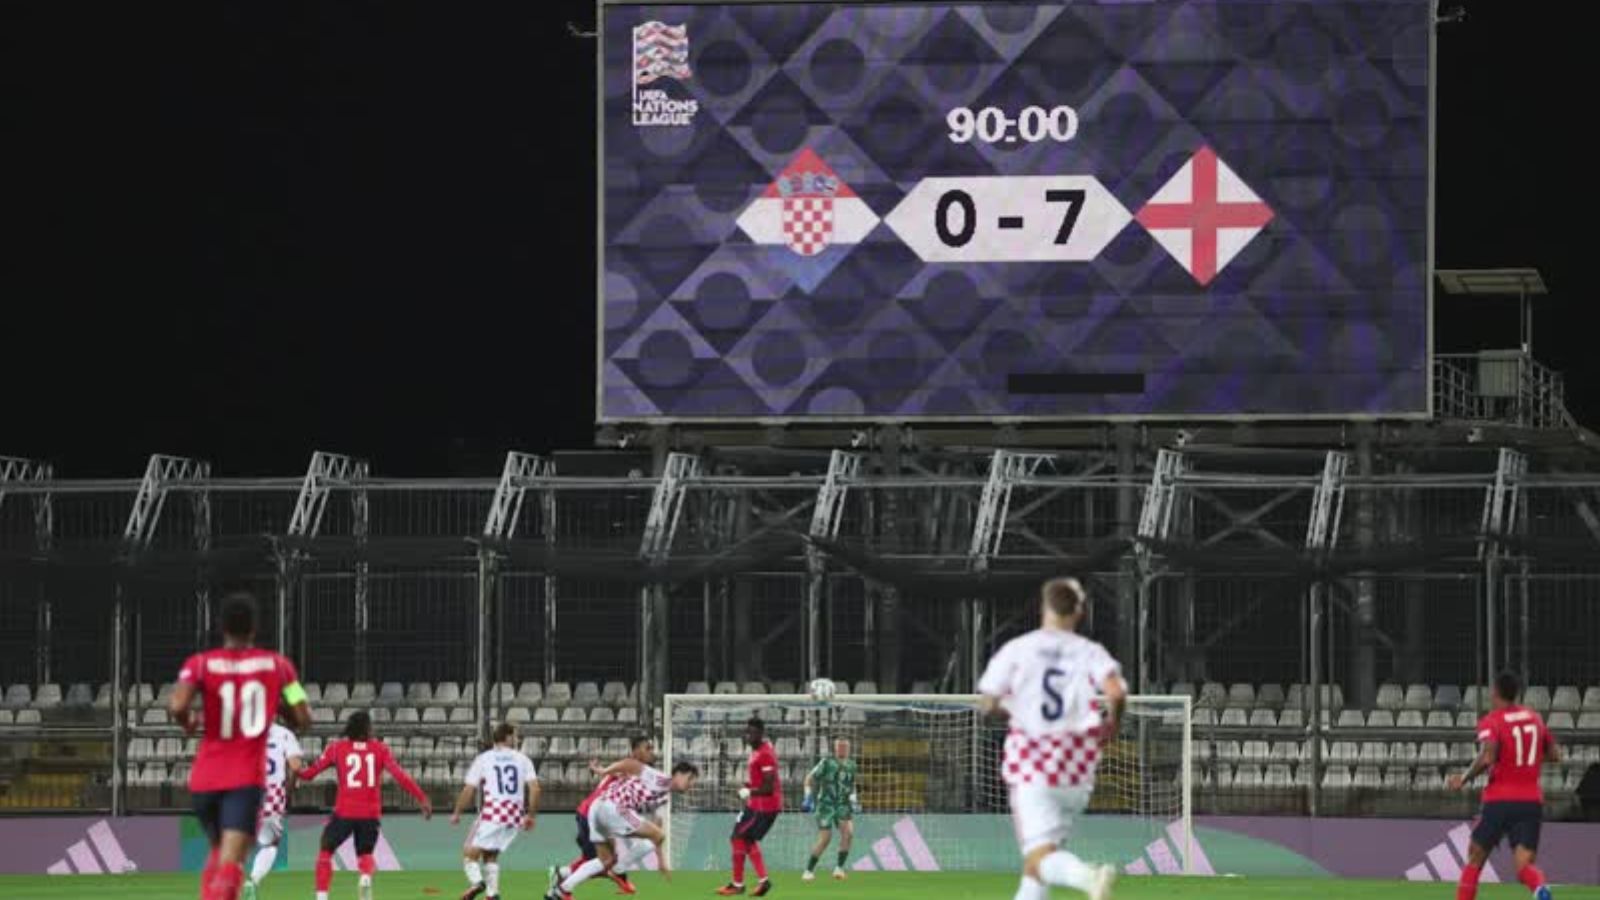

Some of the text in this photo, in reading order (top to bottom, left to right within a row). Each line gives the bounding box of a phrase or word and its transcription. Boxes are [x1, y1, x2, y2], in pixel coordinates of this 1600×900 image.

[632, 100, 698, 112] NATIONS
[639, 89, 669, 100] UEFA
[632, 112, 692, 126] LEAGUE
[946, 105, 1078, 143] 90:00
[935, 189, 1086, 247] 0 - 7
[219, 680, 266, 739] 10
[1041, 667, 1065, 721] 5
[1512, 723, 1538, 767] 17
[346, 753, 376, 788] 21
[494, 764, 518, 795] 13
